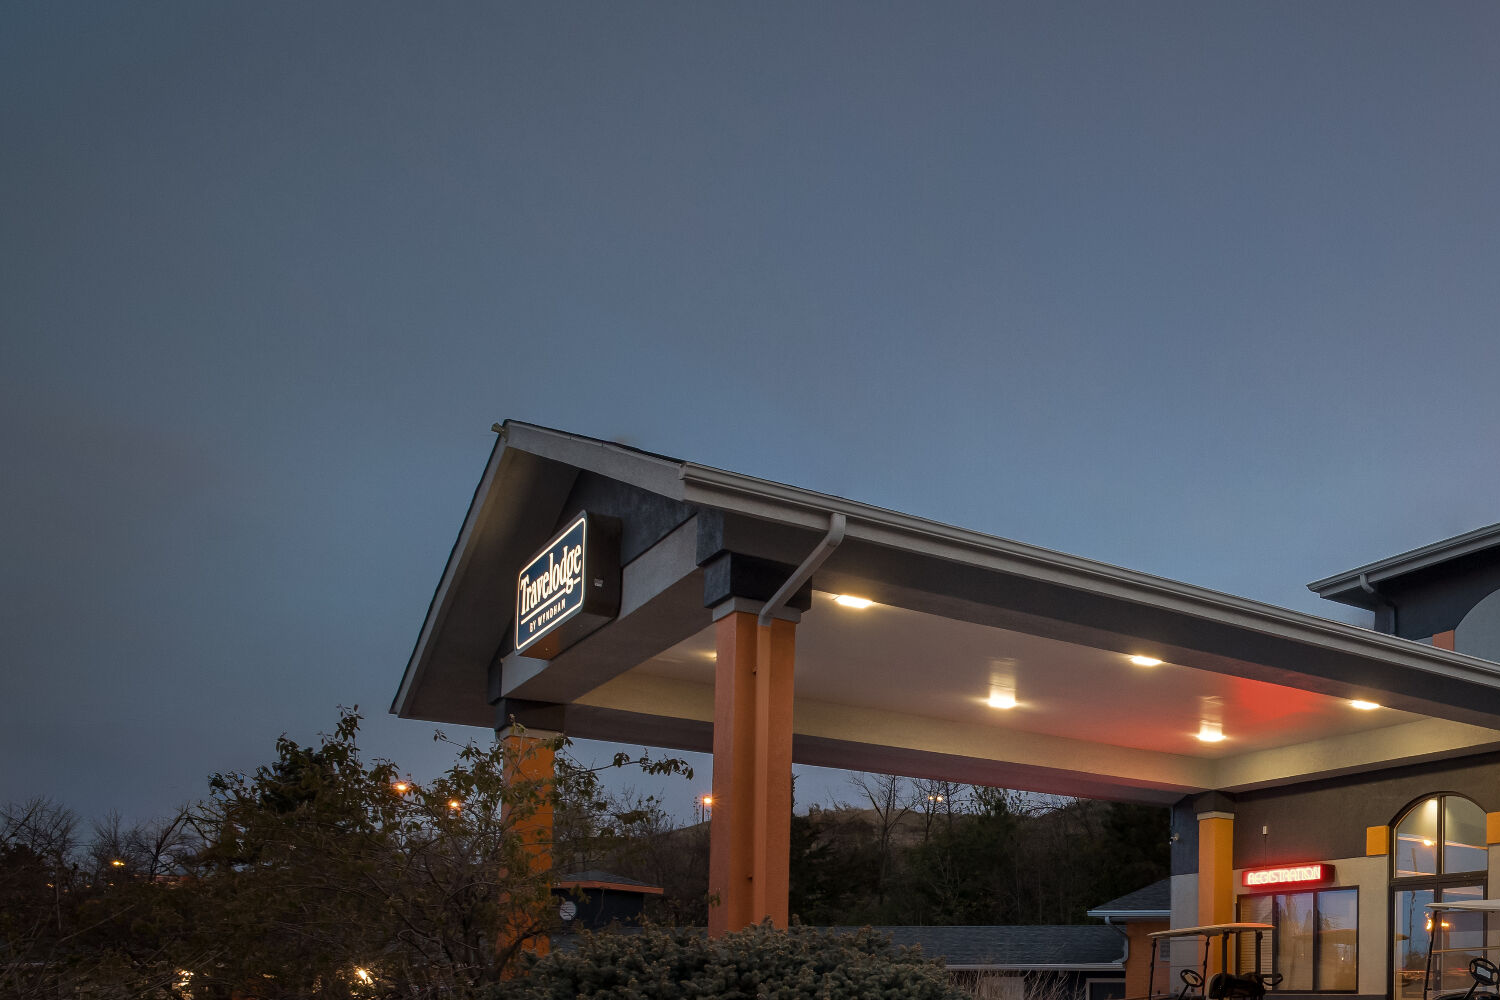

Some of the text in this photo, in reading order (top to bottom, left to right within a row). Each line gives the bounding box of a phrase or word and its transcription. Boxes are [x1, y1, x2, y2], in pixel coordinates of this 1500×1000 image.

[520, 544, 582, 616] Travelodge
[529, 619, 537, 633] BY
[1247, 865, 1321, 886] REGISTRATION
